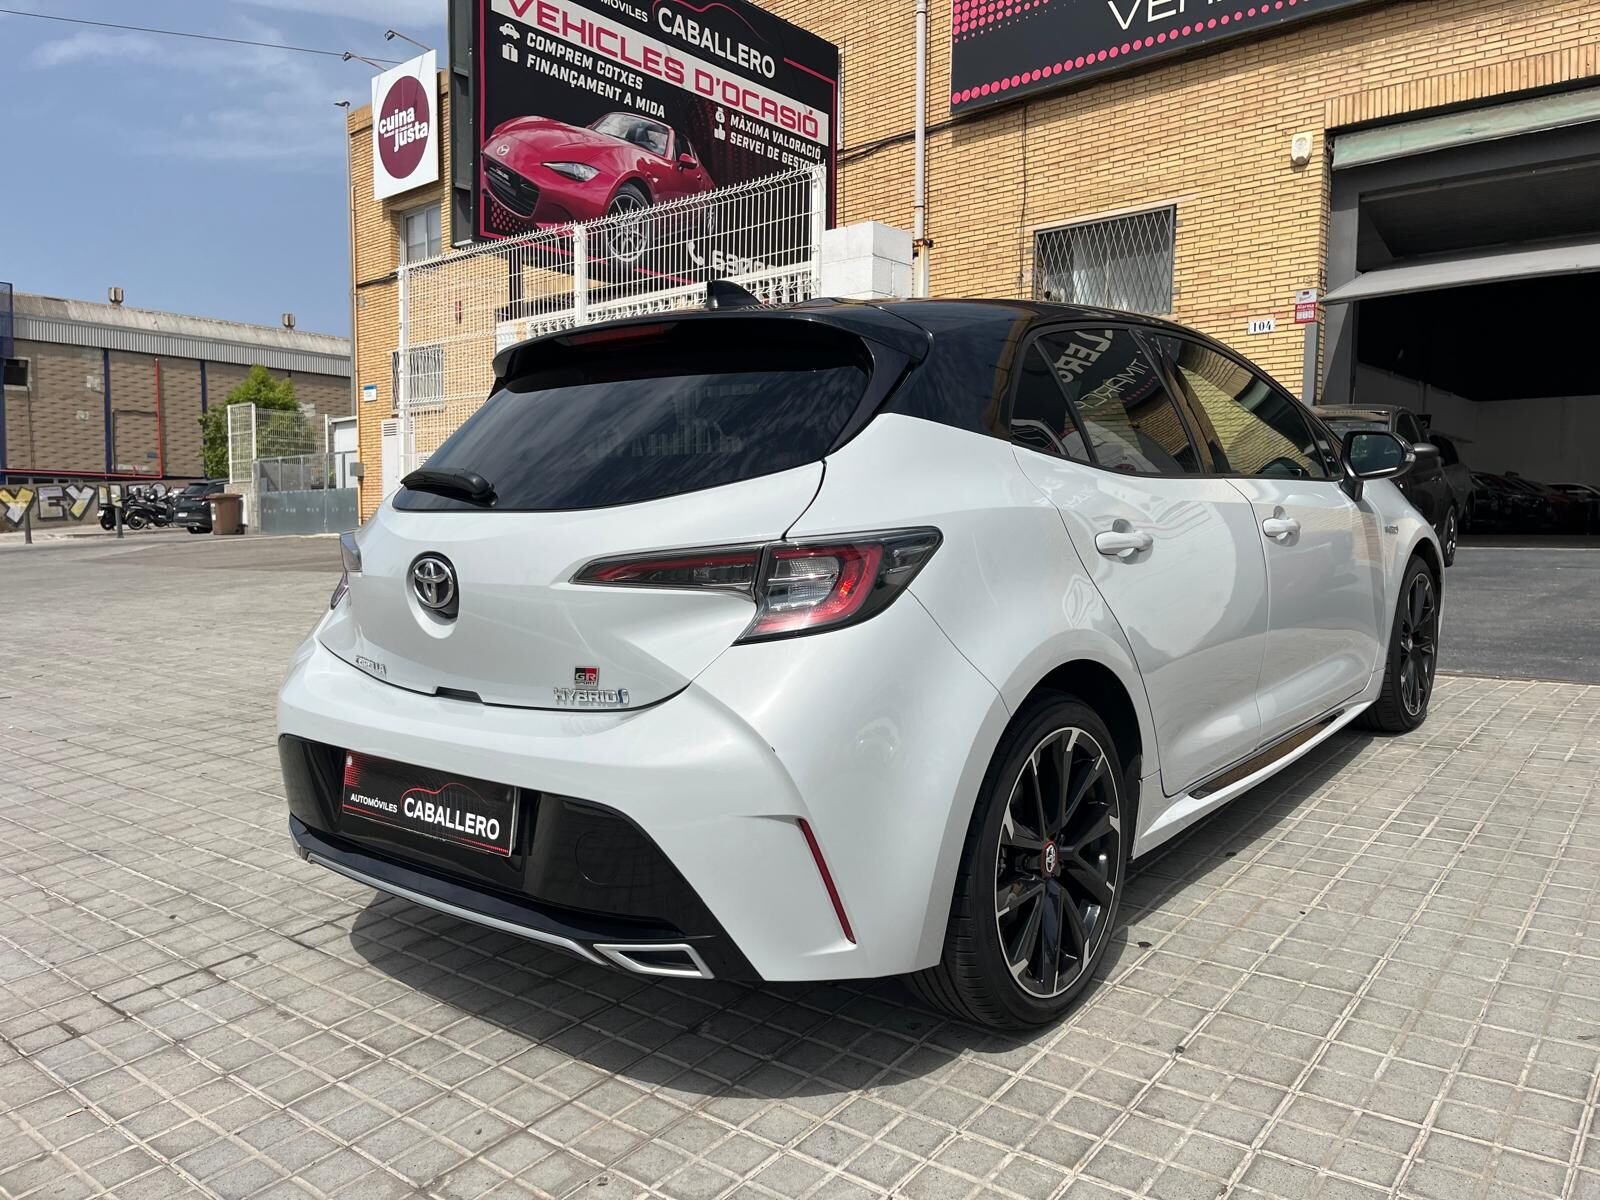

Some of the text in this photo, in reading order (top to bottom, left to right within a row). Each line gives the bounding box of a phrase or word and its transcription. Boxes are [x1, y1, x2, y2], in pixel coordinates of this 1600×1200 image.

[527, 32, 644, 91] COMPREM COTXES
[658, 7, 776, 79] CABALLERO
[508, 0, 819, 139] VEHICLES D'OCASIÓ
[527, 54, 665, 118] FINANÇAMENT A MIDA
[380, 107, 415, 134] cuina
[394, 121, 428, 152] justa
[730, 114, 821, 160] MÀXIMA VALORACIÓ
[729, 131, 765, 156] SERVEI
[767, 145, 780, 160] DE
[1253, 320, 1271, 332] 104
[553, 687, 618, 703] HYBRID
[575, 672, 596, 681] GR
[350, 792, 500, 840] AUTOMÓVILES CABALLERO
